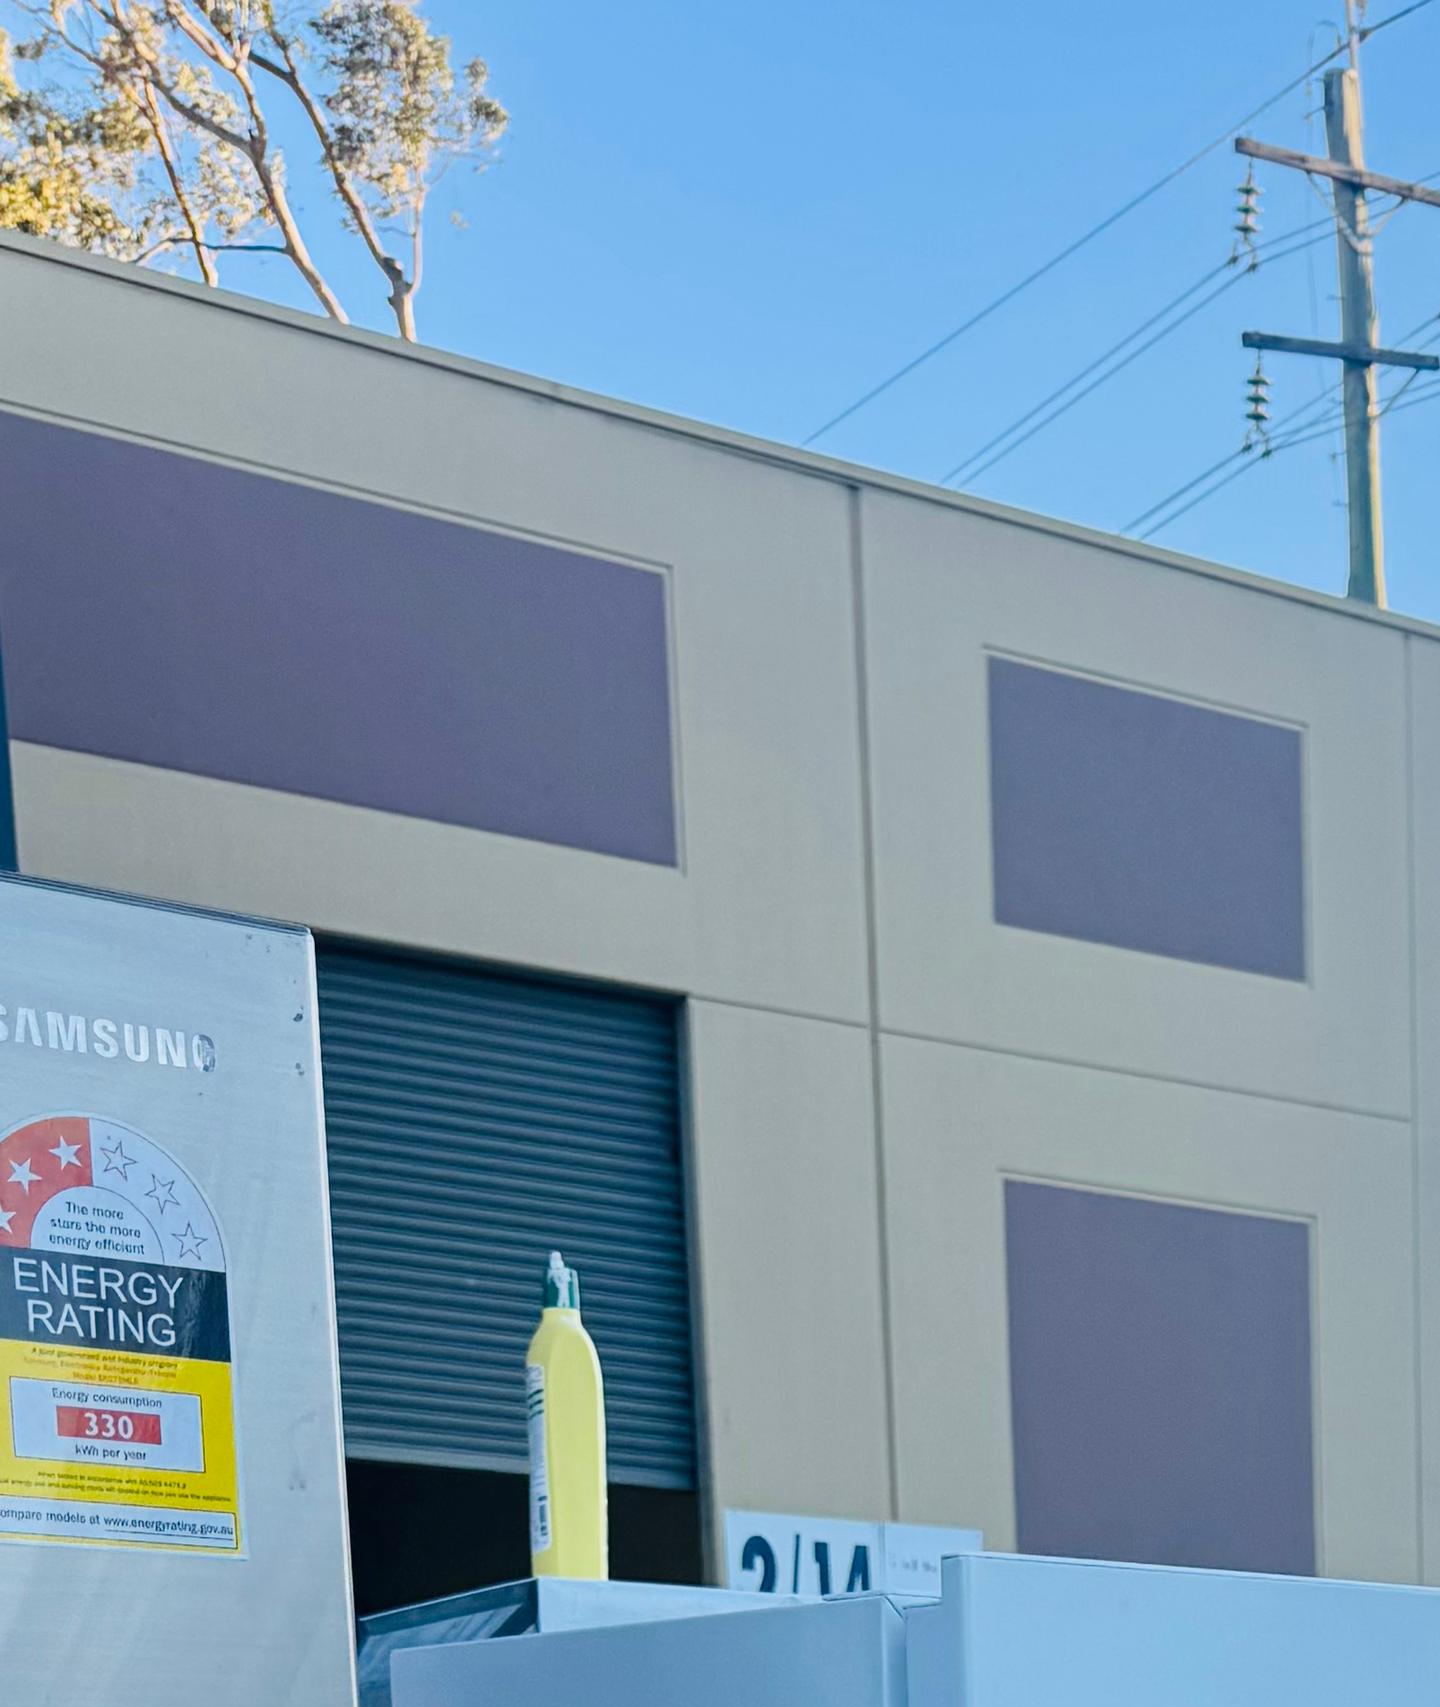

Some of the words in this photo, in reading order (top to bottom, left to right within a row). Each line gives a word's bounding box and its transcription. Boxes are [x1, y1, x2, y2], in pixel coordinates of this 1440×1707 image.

[65, 1201, 89, 1216] The
[93, 1207, 124, 1220] more
[110, 1226, 141, 1239] more
[13, 1257, 184, 1309] ENERGY
[27, 1299, 177, 1347] RATING
[52, 1387, 88, 1403] Energy
[93, 1393, 162, 1409] consumption
[84, 1412, 134, 1439] 330
[75, 1444, 99, 1457] kWh
[0, 1509, 42, 1523] ompare
[103, 1515, 234, 1536] www.energyrating.gov.au
